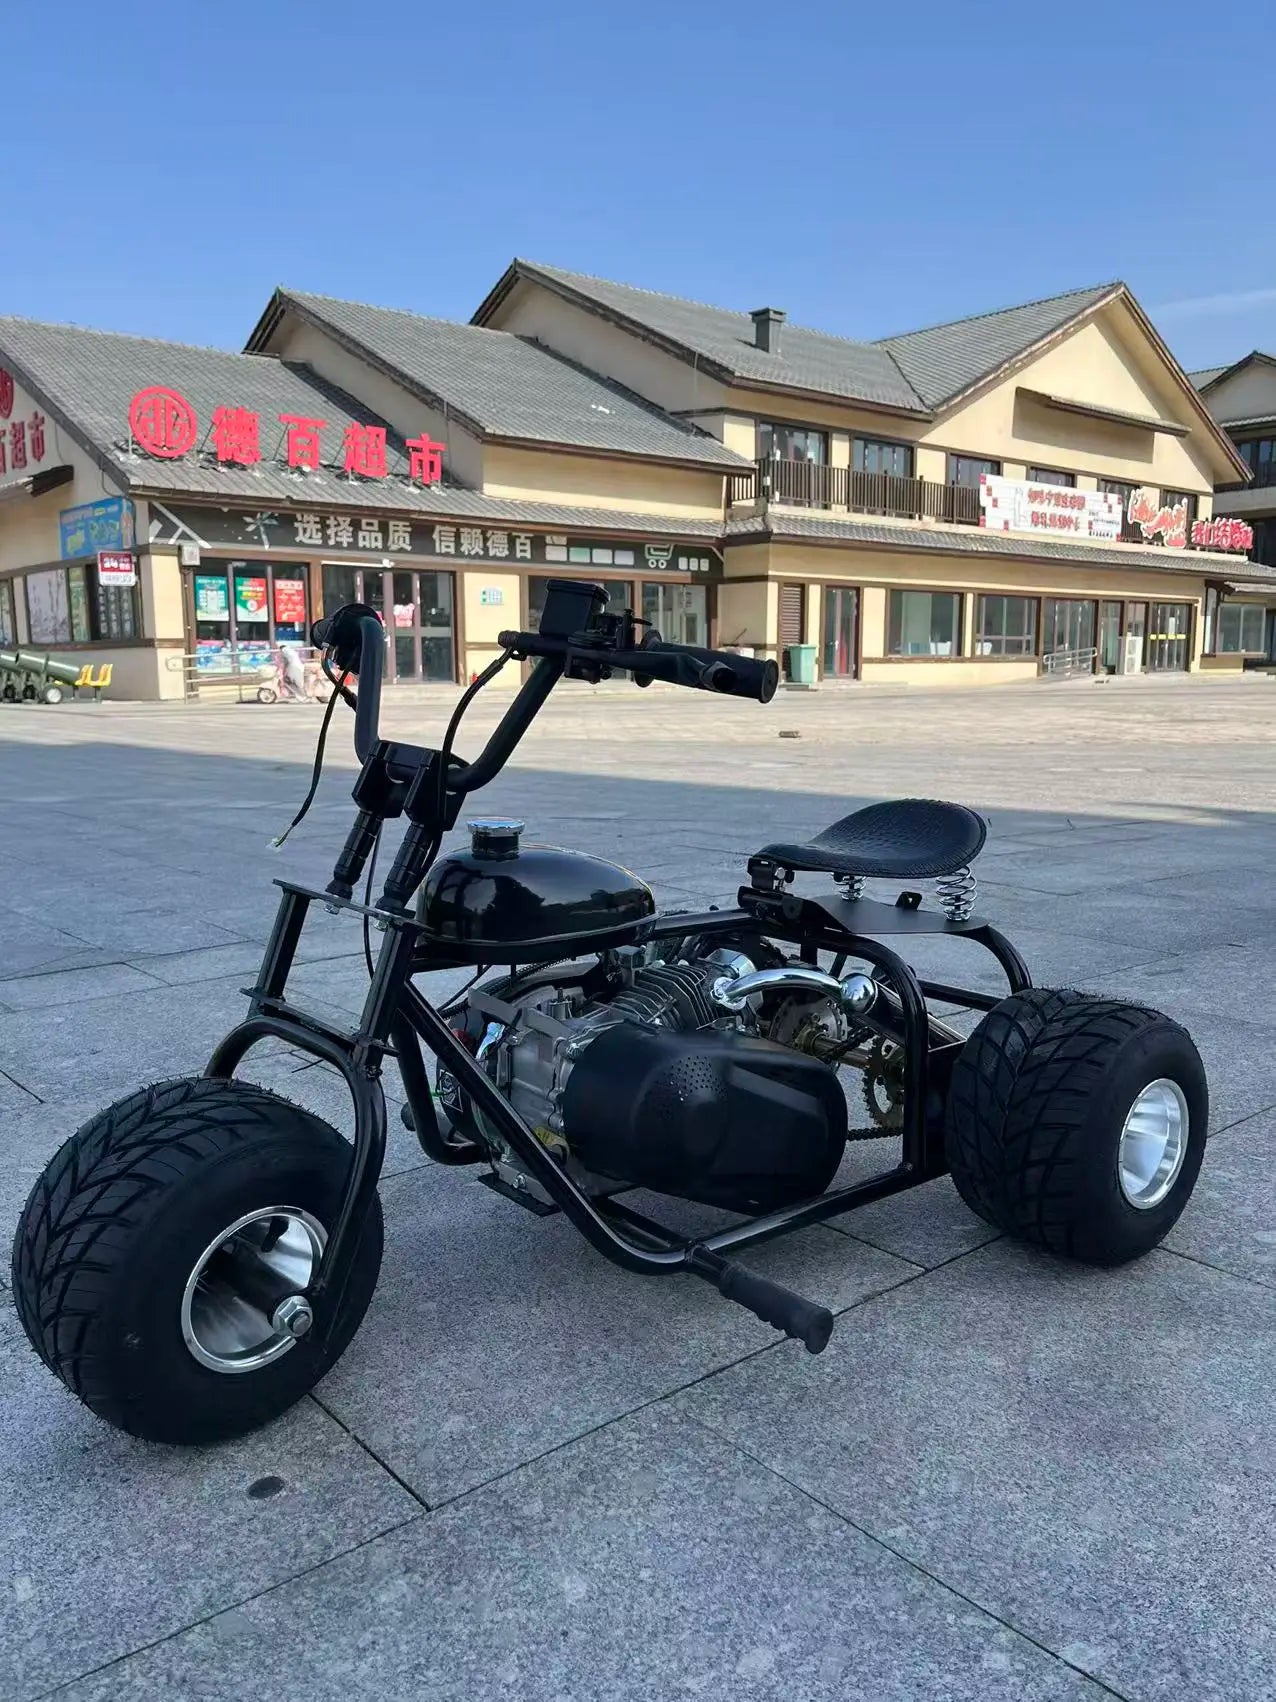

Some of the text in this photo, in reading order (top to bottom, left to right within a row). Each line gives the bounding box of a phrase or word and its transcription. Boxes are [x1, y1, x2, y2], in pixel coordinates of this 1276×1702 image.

[211, 404, 446, 485] 德百超市
[294, 513, 534, 560] 选择品质 信赖德百
